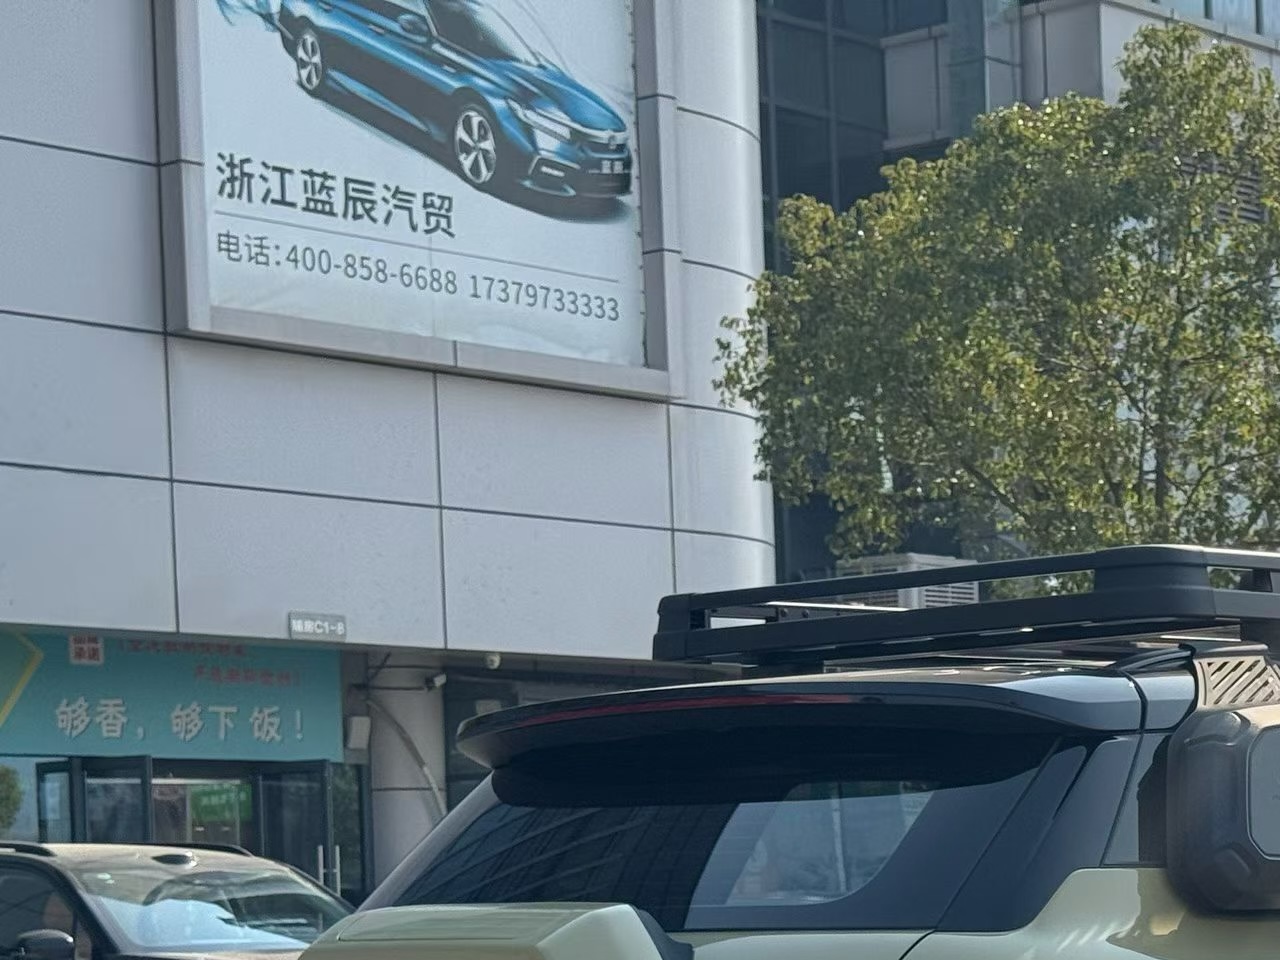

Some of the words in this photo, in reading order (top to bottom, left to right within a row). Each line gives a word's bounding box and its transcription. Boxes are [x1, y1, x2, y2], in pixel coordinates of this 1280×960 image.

[217, 152, 456, 238] 浙江蓝辰汽贸
[469, 274, 620, 321] 17379733333
